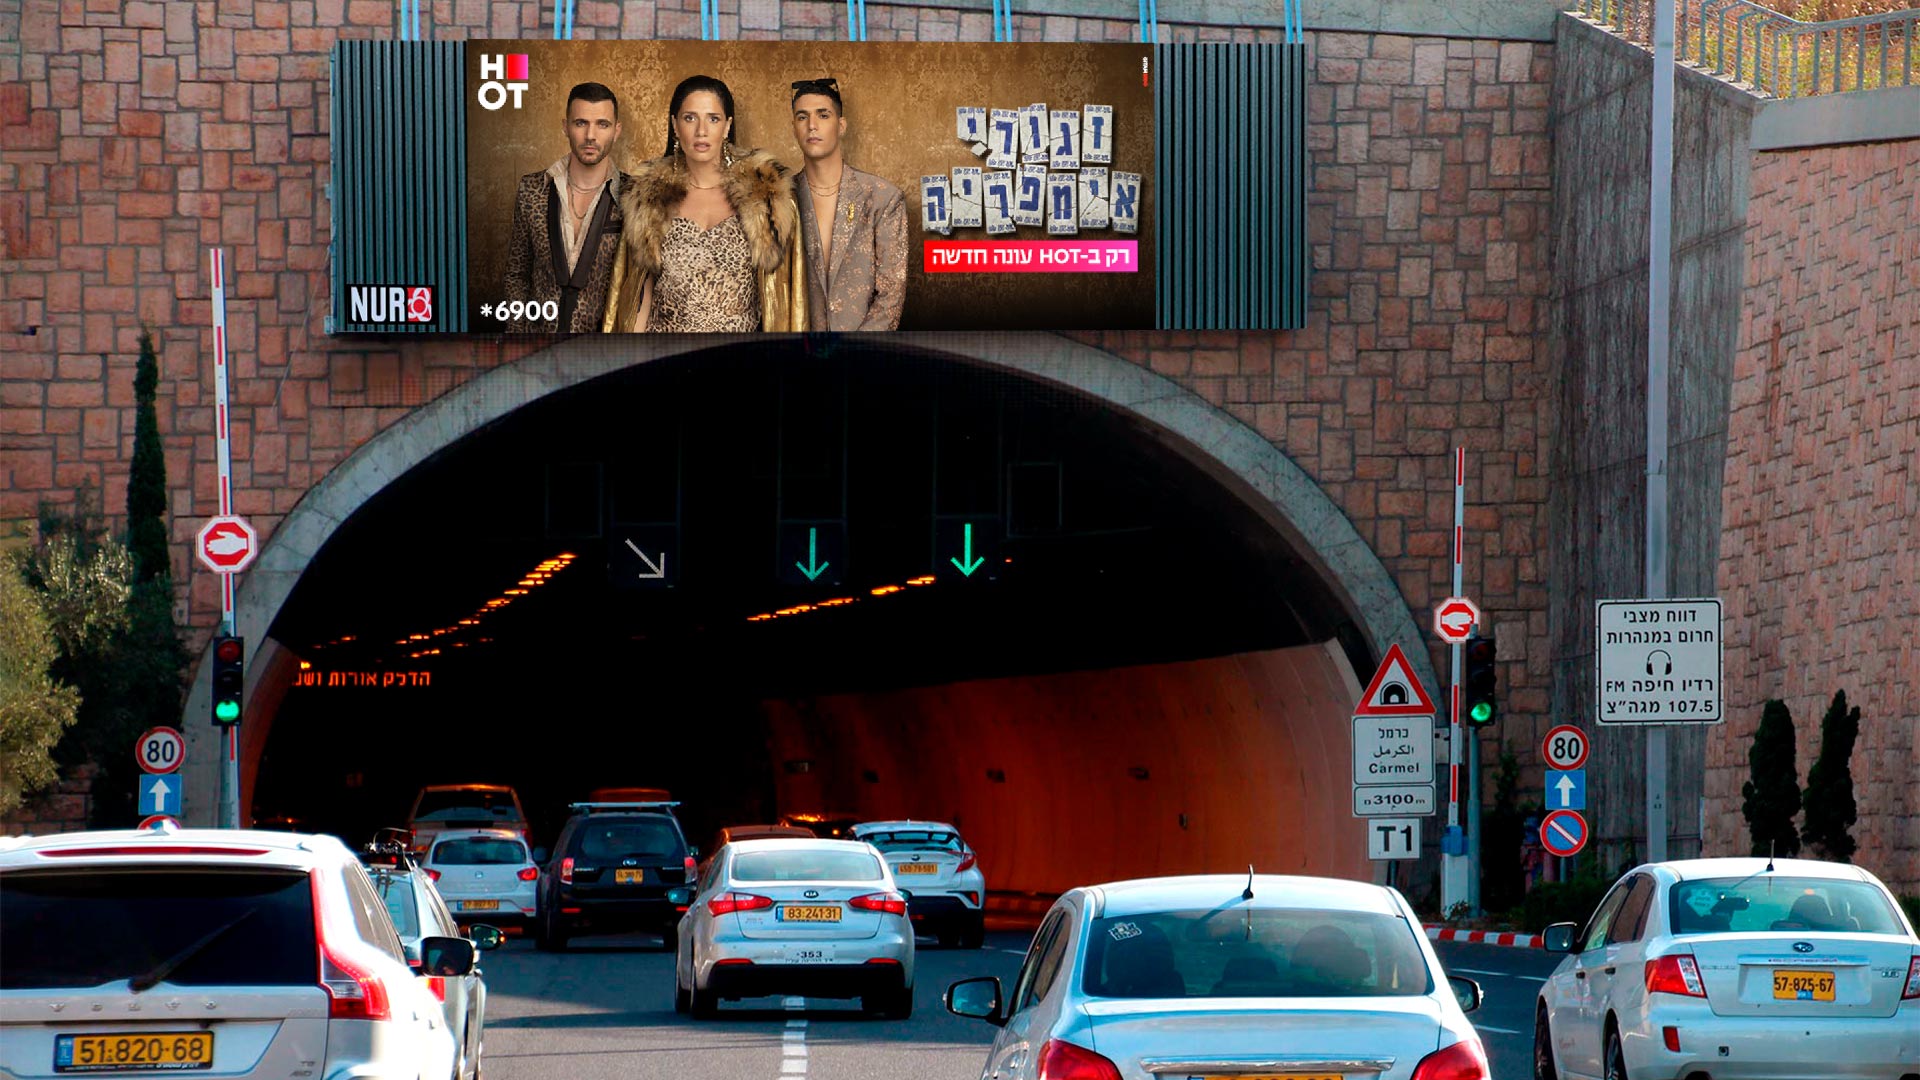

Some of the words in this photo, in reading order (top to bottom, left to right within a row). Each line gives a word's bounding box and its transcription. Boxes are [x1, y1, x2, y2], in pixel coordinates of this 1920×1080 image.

[967, 116, 1104, 155] זגורי
[927, 176, 1136, 221] אימפריה
[932, 249, 987, 265] חדשה
[993, 249, 1033, 265] עונה
[1105, 249, 1130, 267] רק
[351, 286, 405, 322] NUR
[1624, 611, 1660, 623] מצבי
[1667, 610, 1696, 622] דווח
[1606, 631, 1672, 644] במנהרות
[1678, 630, 1713, 642] חרום
[328, 671, 377, 686] אורות
[1682, 680, 1713, 691] רדיו
[1606, 681, 1625, 692] FM
[1632, 680, 1674, 692] חיפה
[1669, 700, 1713, 713] 107.5
[1378, 727, 1409, 739] כרמל
[147, 740, 175, 763] 80
[1373, 744, 1414, 758] الكرمل
[1553, 737, 1580, 760] 80
[1369, 762, 1419, 774] Carmel
[1376, 825, 1412, 852] T1
